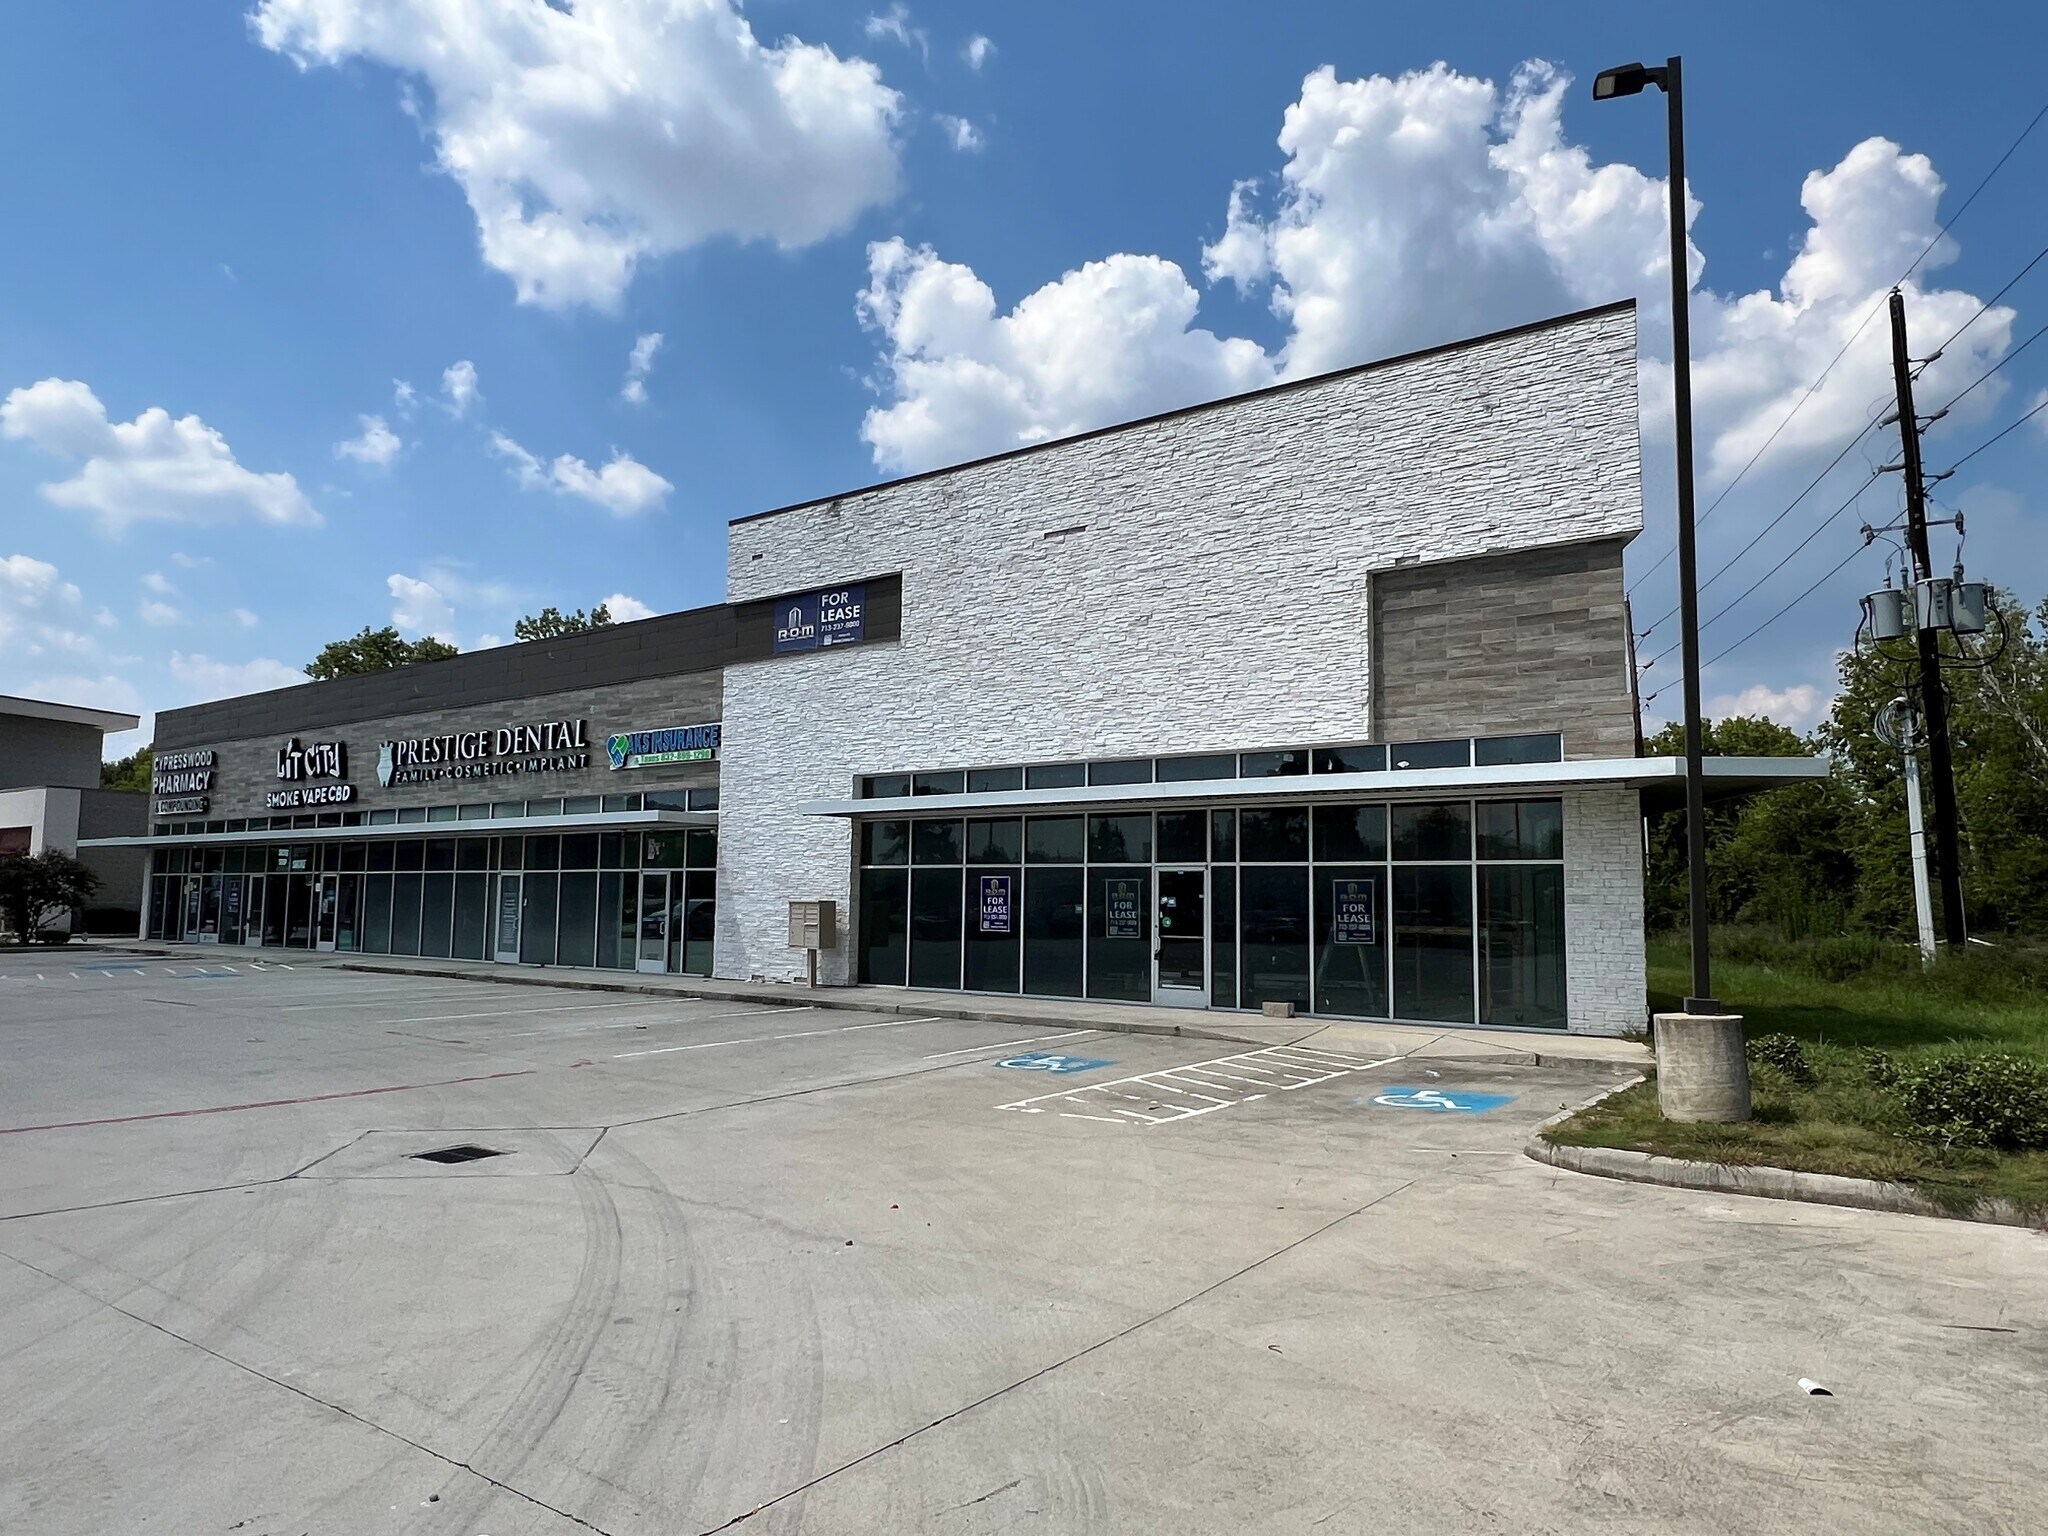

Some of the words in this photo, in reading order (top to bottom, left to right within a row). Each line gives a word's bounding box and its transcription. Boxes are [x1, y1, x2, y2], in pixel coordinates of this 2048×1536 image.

[821, 591, 849, 607] FOR
[821, 605, 860, 622] LEASE
[397, 730, 488, 765] PRESTIGE
[496, 719, 585, 756] DENTAL
[651, 725, 718, 754] INSURANCE
[153, 750, 212, 772] CYPRESSWOOD
[395, 769, 438, 783] FAMILY
[446, 761, 514, 779] COSMETIC
[522, 754, 587, 772] IMPLANT
[152, 770, 211, 794] PHARMACY
[266, 790, 300, 808] SMOKE
[302, 787, 328, 804] VAPE
[328, 785, 351, 802] CBD
[987, 897, 1004, 905] FOR
[1114, 901, 1133, 910] FOR
[1342, 903, 1365, 913] FOR
[983, 905, 1007, 914] LEASE
[1109, 910, 1137, 919] LEASE
[1337, 914, 1371, 923] LEASE
